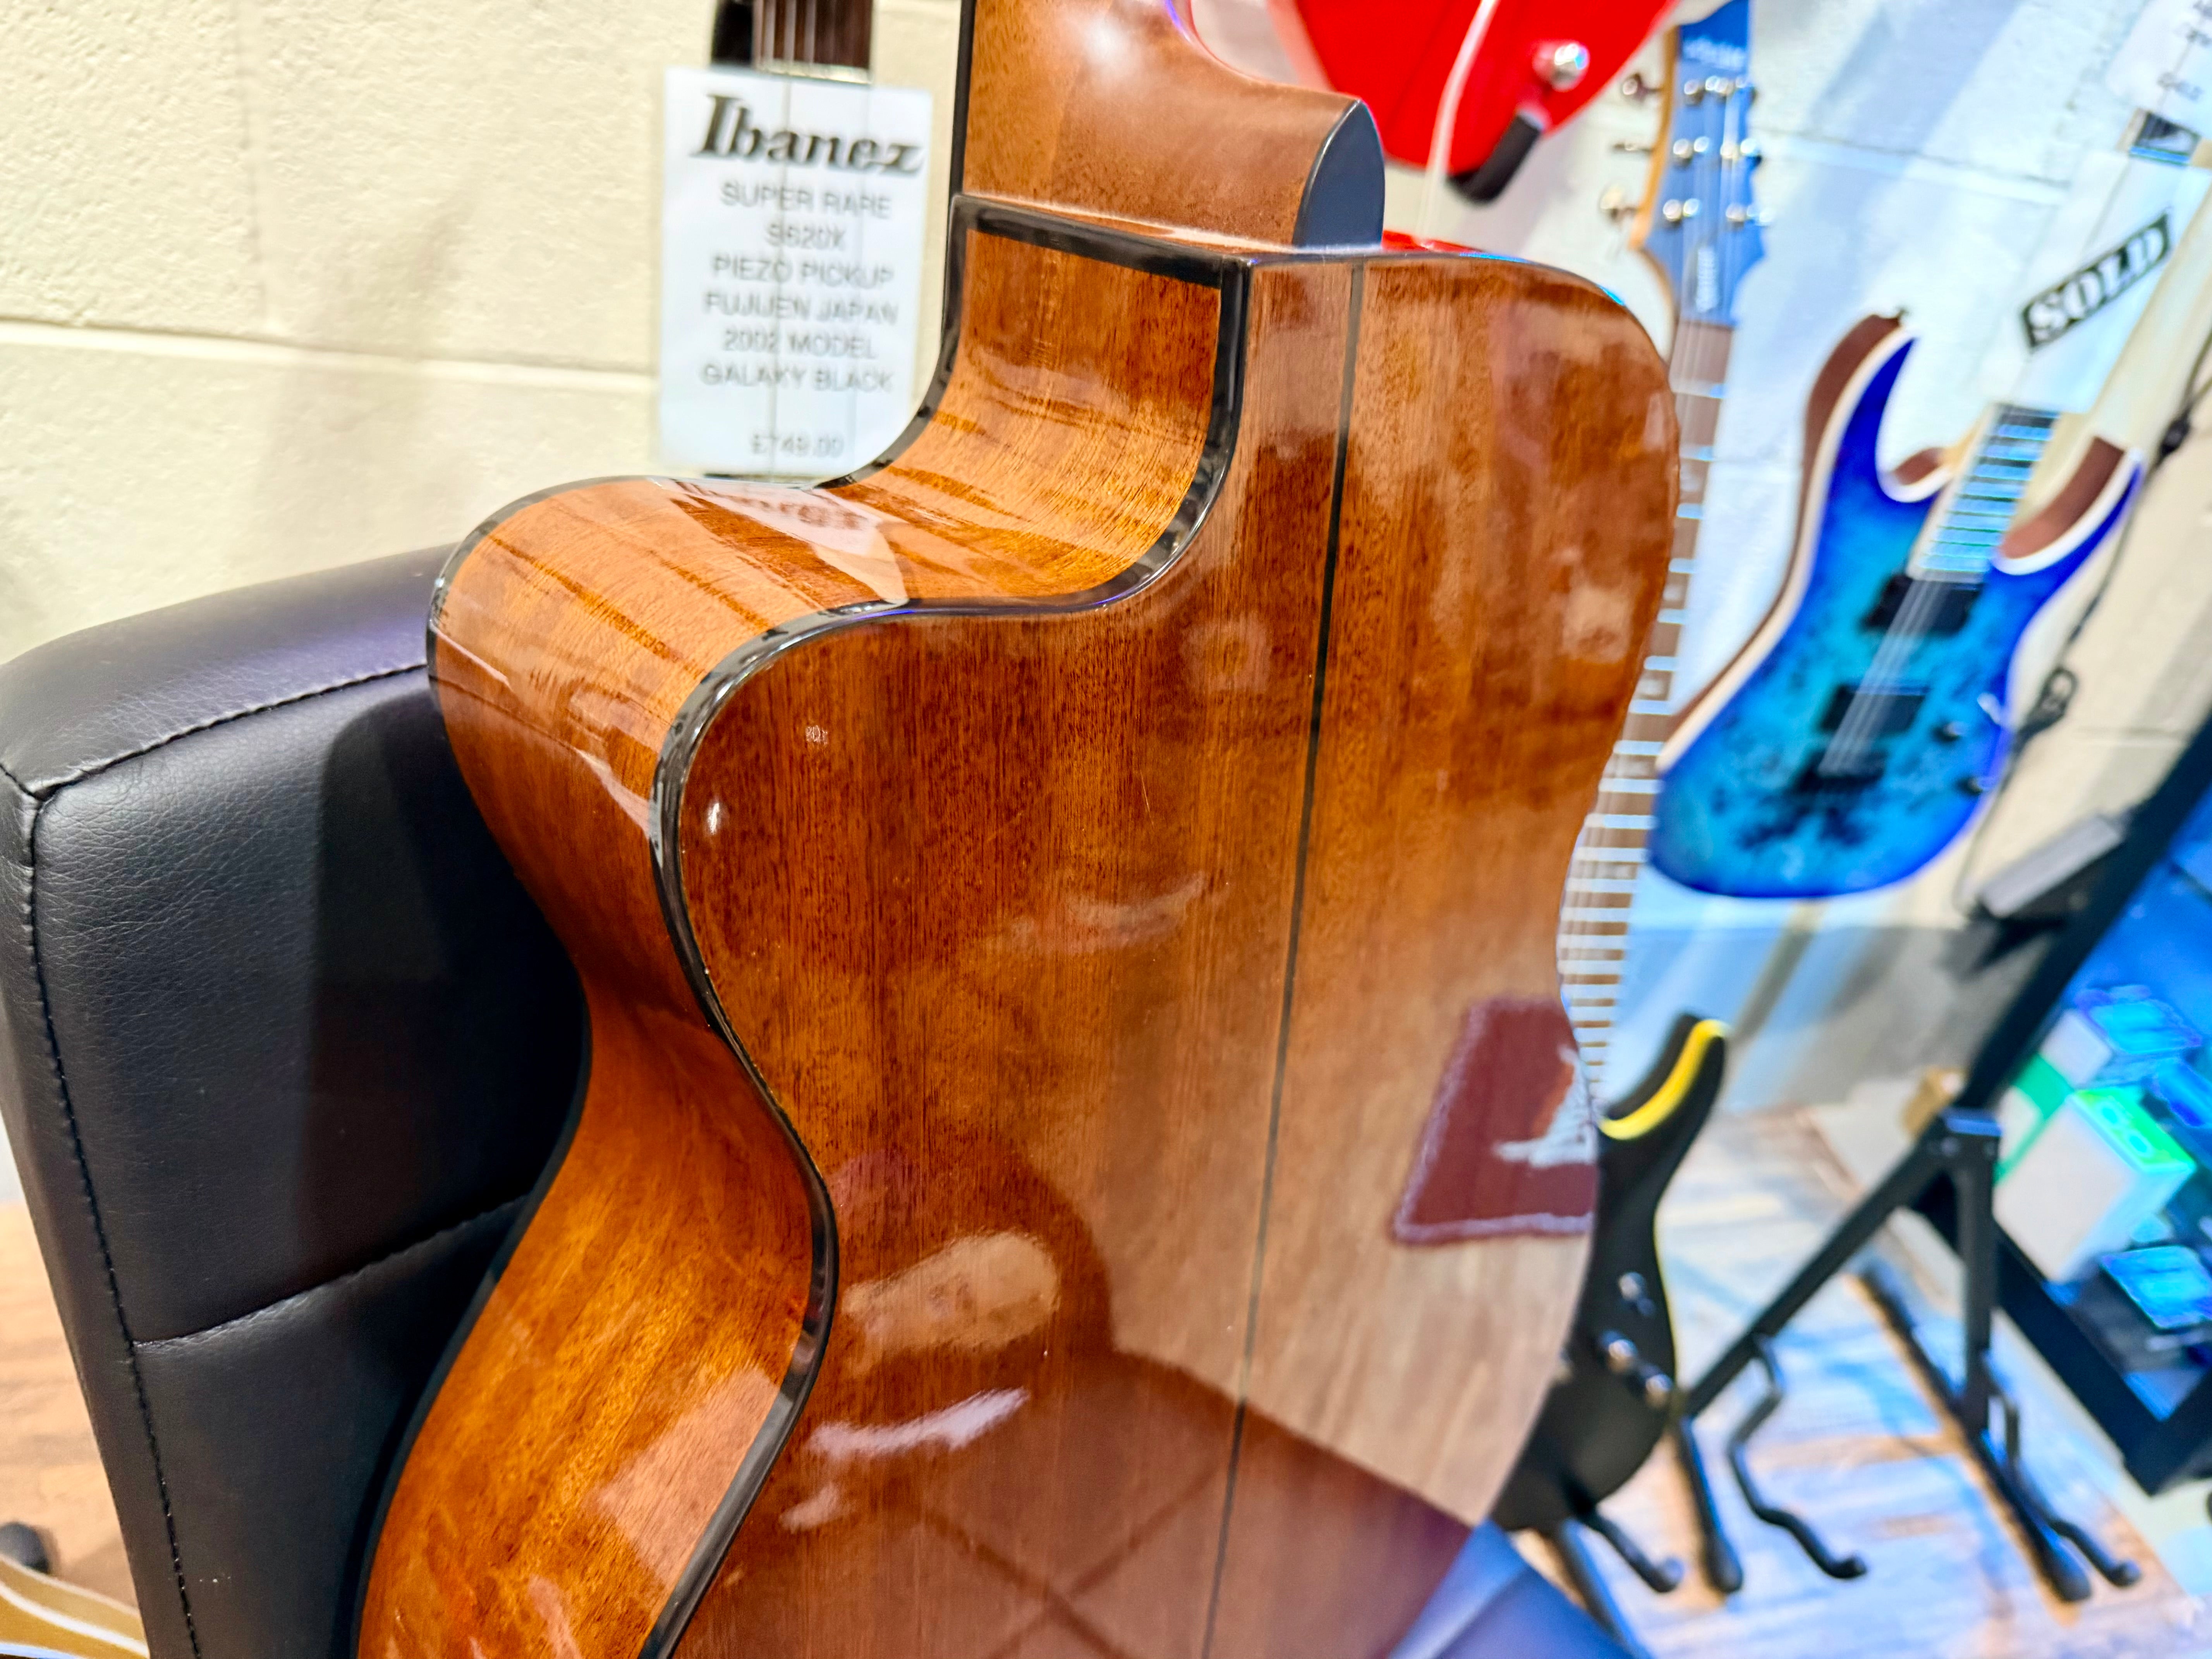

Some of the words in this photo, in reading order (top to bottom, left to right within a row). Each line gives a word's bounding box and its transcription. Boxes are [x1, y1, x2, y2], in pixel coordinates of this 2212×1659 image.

[691, 93, 923, 177] Ibanez
[721, 182, 812, 211] SUPER
[823, 193, 891, 218] RARE
[712, 255, 791, 283] PIEZO
[802, 262, 894, 288] PICKUP
[2028, 228, 2165, 340] SOLD
[817, 299, 898, 325] JAPAN
[788, 331, 878, 359] MODEL
[700, 361, 805, 386] GALAXY
[813, 368, 894, 393] BLACK
